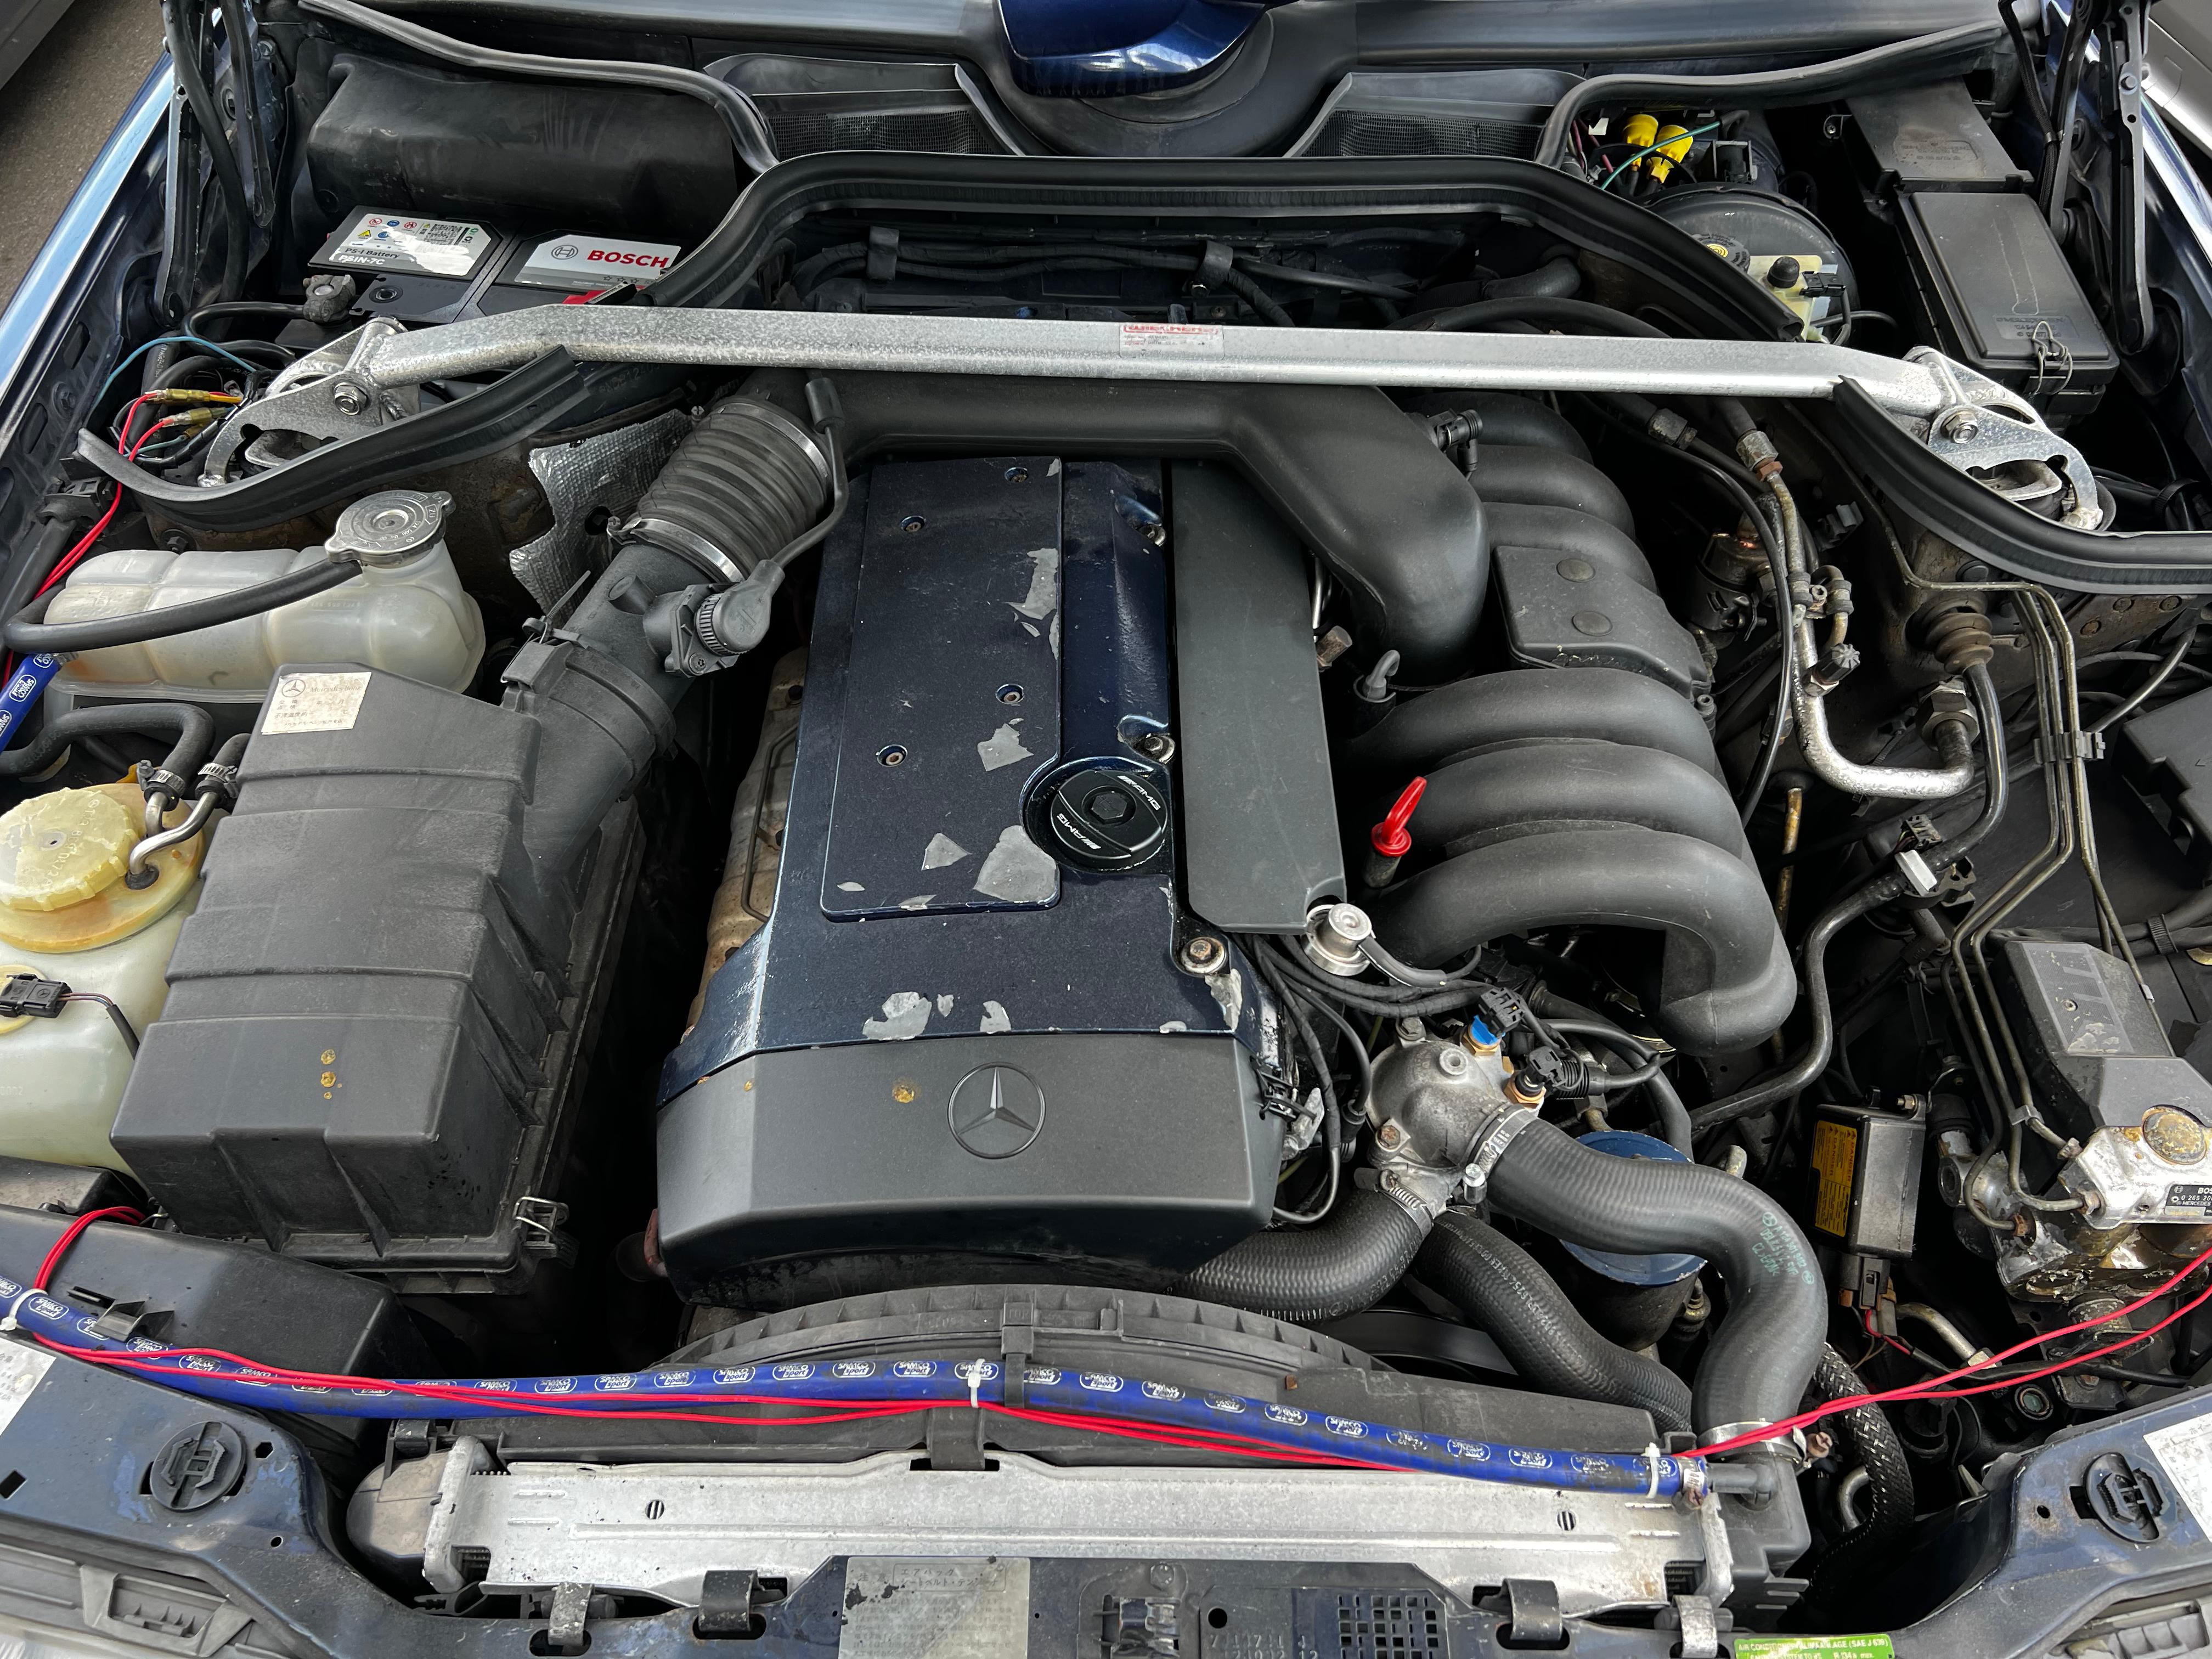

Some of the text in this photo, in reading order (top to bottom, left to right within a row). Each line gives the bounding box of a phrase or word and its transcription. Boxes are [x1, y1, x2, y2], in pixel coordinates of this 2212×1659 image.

[345, 248, 400, 259] PS-I Battery
[338, 255, 385, 265] PSIN-7C
[587, 250, 669, 269] BOSCH
[1847, 1141, 1857, 1182] DANGER
[240, 1368, 272, 1378] SAMCO
[901, 1567, 956, 1576] エアバッグ
